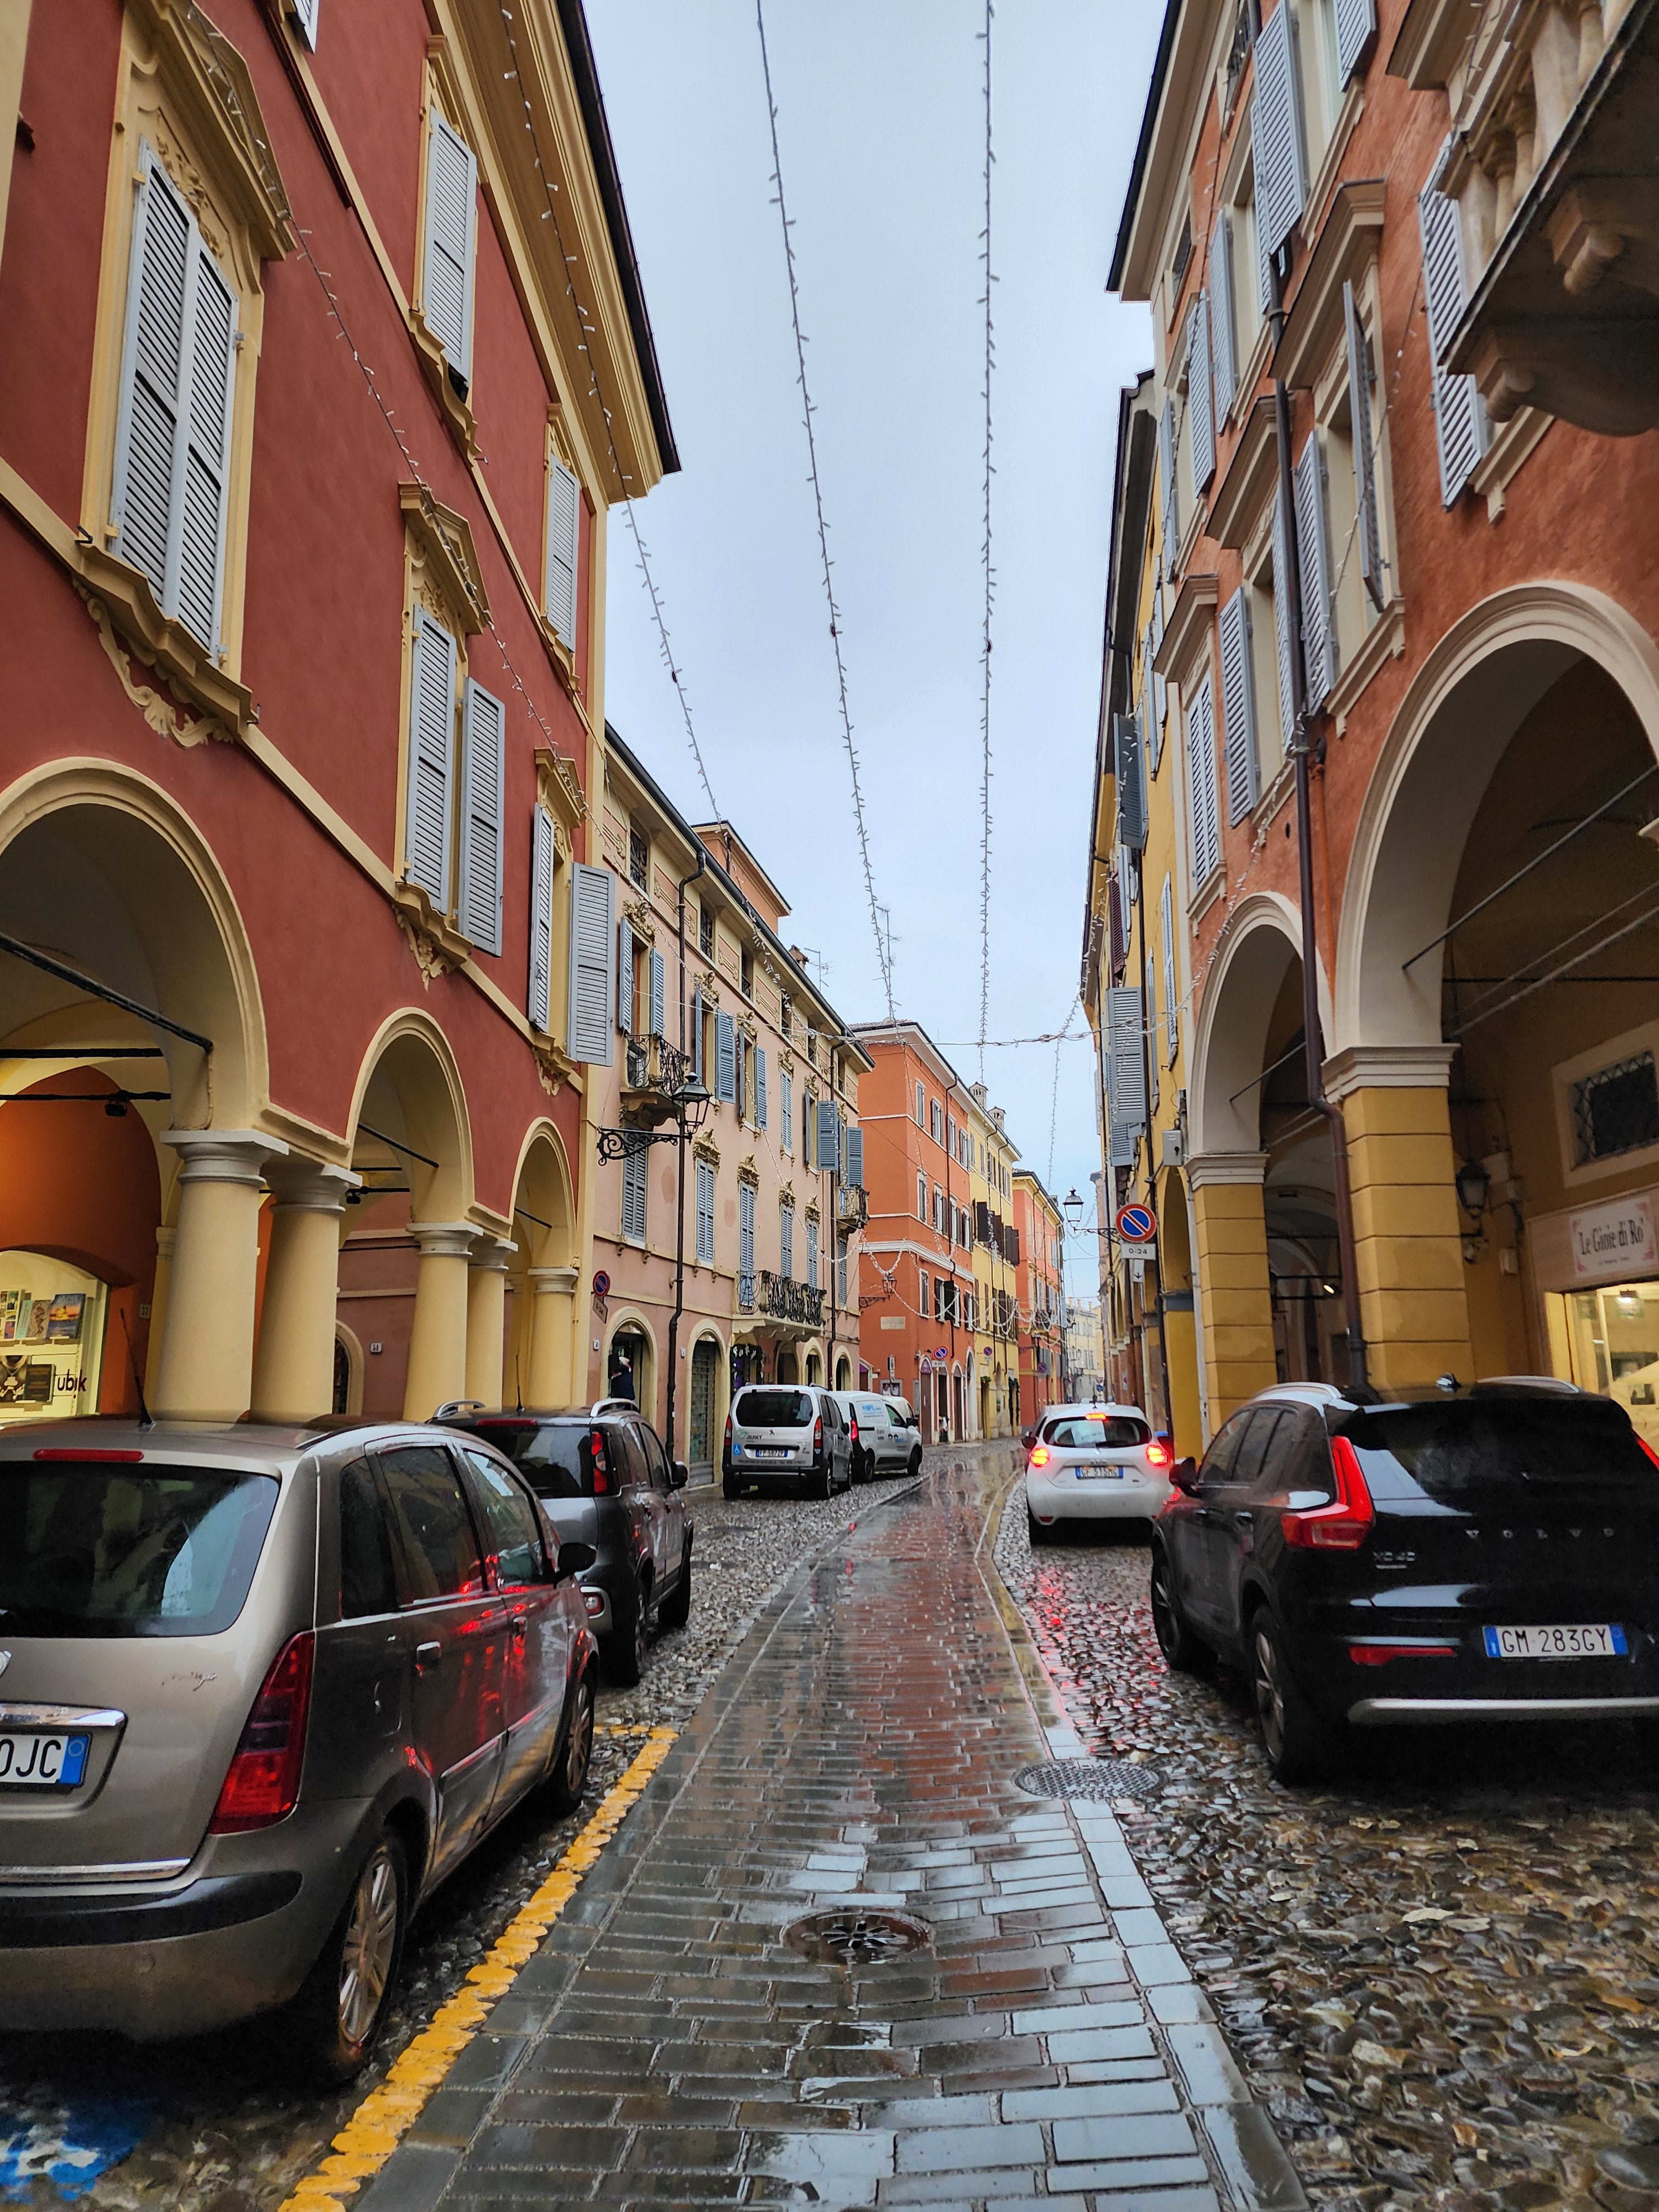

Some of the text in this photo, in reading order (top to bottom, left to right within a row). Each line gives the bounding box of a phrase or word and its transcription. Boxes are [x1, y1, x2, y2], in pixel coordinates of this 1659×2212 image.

[1579, 1232, 1591, 1255] Le
[1593, 1224, 1616, 1253] Gioie
[1619, 1221, 1629, 1246] di
[57, 1368, 87, 1399] ubik
[1501, 1630, 1531, 1653] GM
[1538, 1627, 1607, 1653] 283GY
